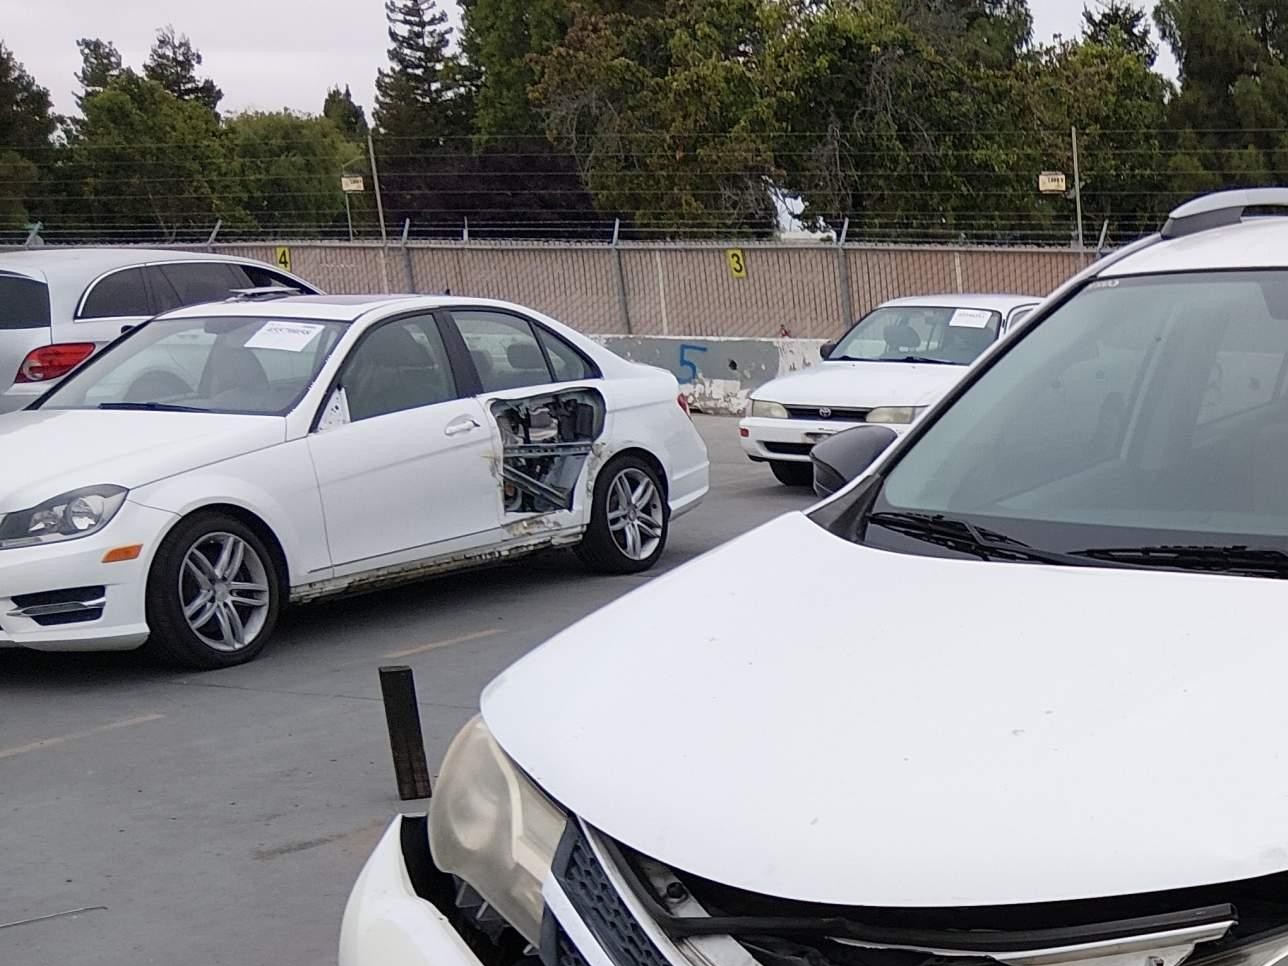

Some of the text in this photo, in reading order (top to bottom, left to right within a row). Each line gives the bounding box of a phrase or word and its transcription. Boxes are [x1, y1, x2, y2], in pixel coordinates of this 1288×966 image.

[279, 249, 289, 269] 4
[731, 252, 743, 273] 3
[679, 344, 708, 385] 5
